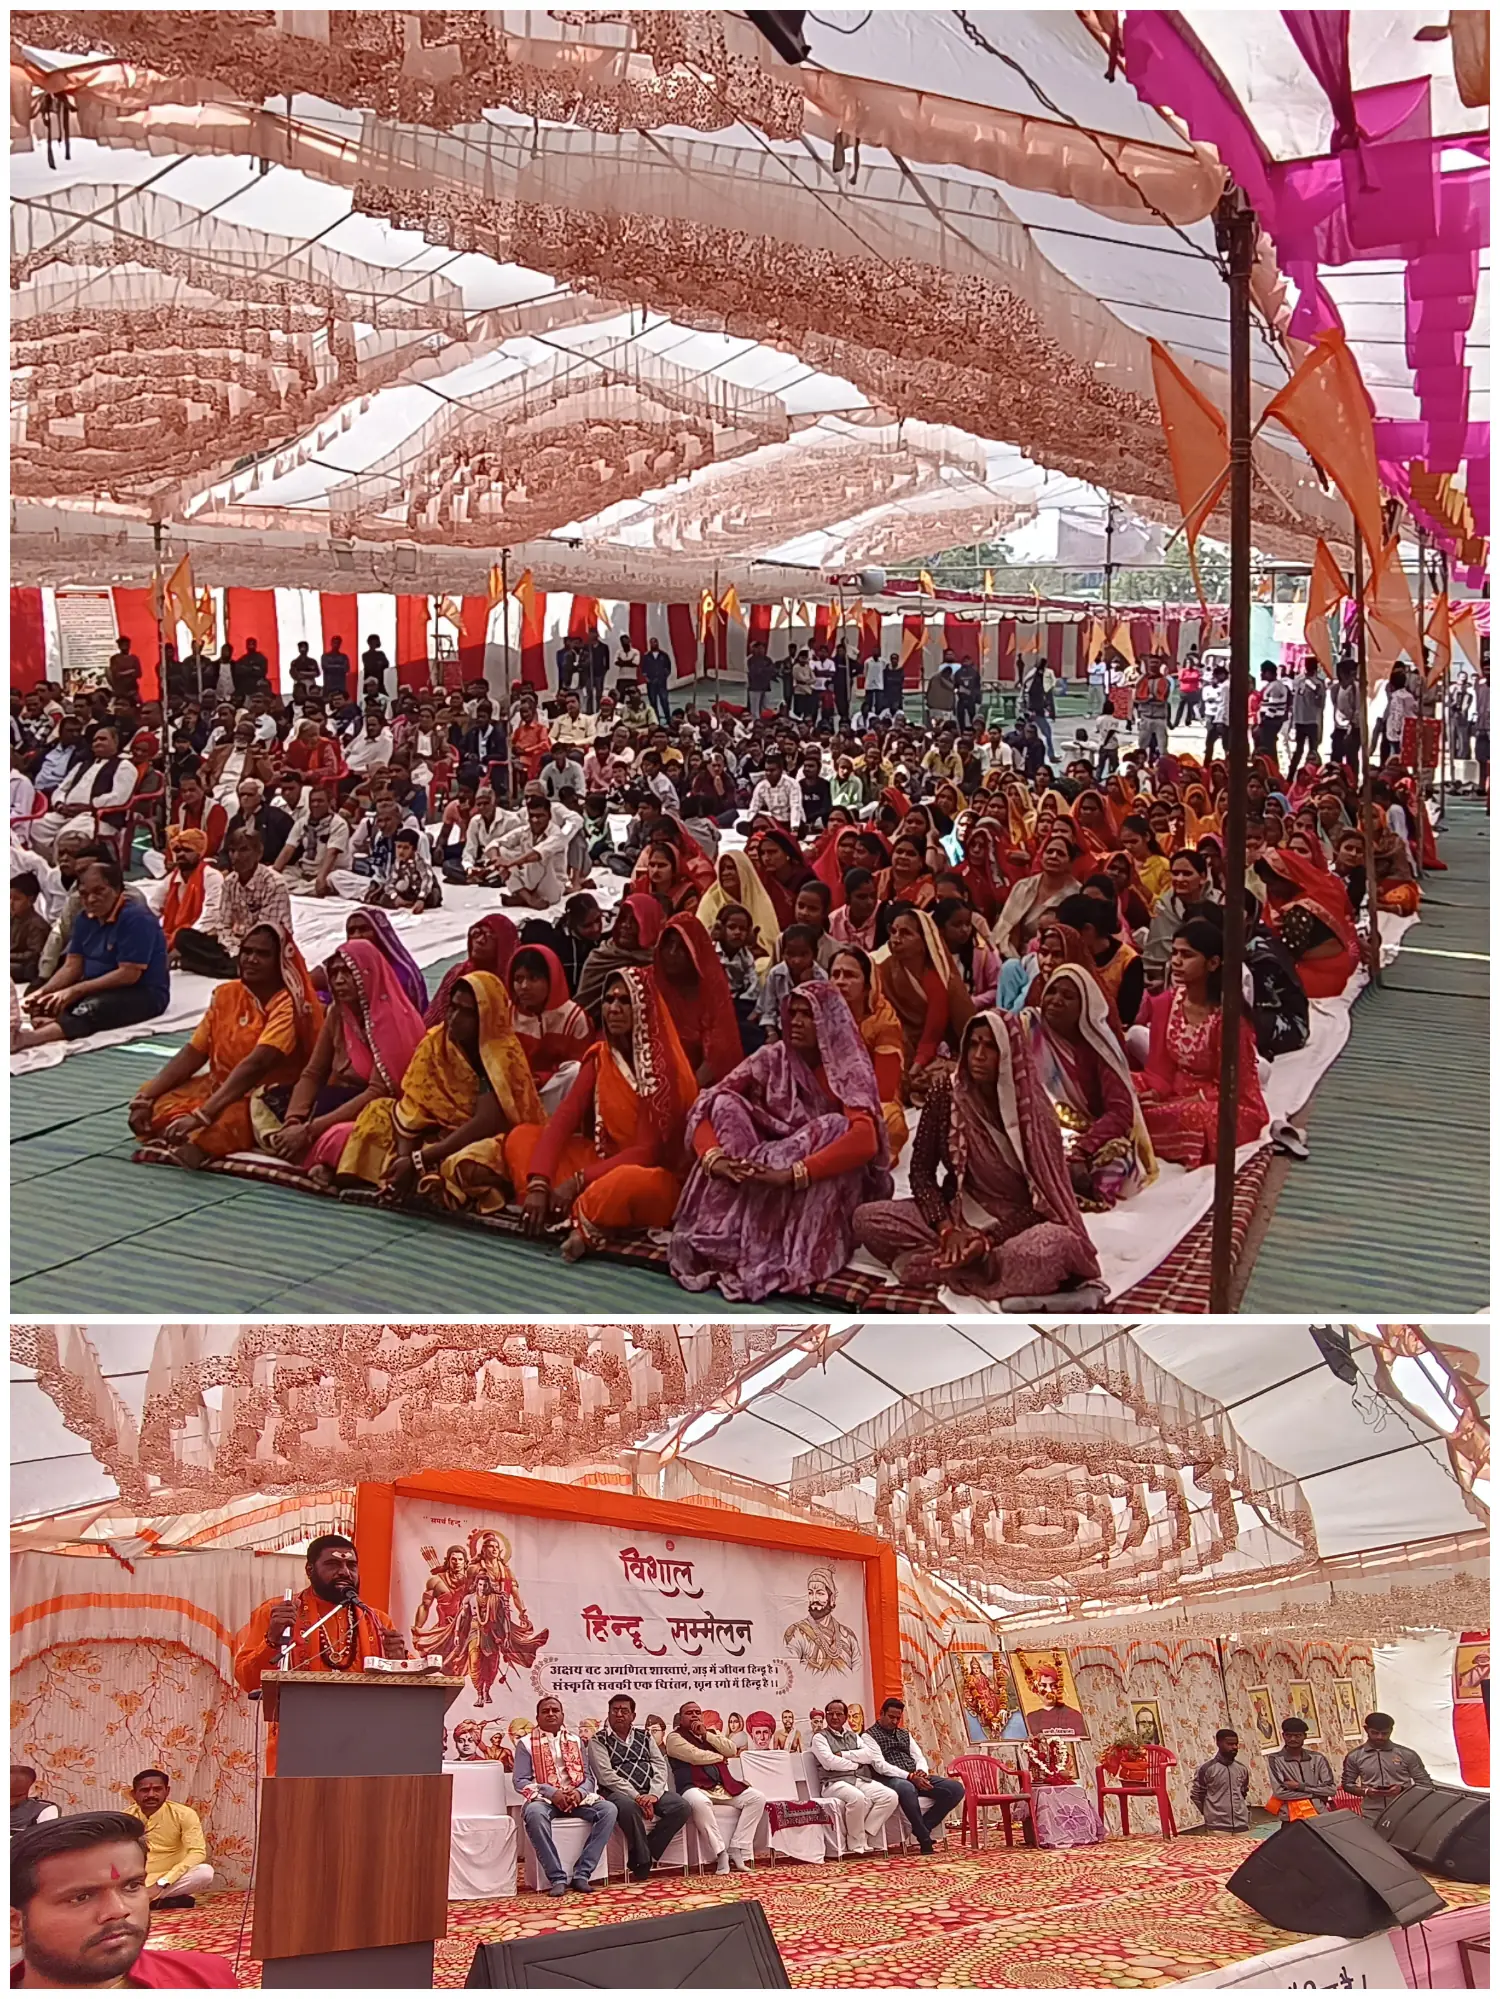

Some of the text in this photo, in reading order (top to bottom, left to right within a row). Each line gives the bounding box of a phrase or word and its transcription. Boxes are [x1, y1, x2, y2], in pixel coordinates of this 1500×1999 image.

[618, 1546, 704, 1599] विशाल
[580, 1603, 753, 1657] हिन्दू सम्मेलन
[550, 1665, 583, 1675] अक्षय
[604, 1664, 647, 1675] अगणित
[692, 1666, 708, 1677] जड़
[709, 1663, 717, 1675] में
[719, 1664, 745, 1675] जीवन
[747, 1664, 767, 1676] हिन्दू
[552, 1678, 595, 1693] संस्कृति
[633, 1681, 652, 1690] एक
[732, 1677, 740, 1689] में
[742, 1678, 761, 1690] हिन्दू
